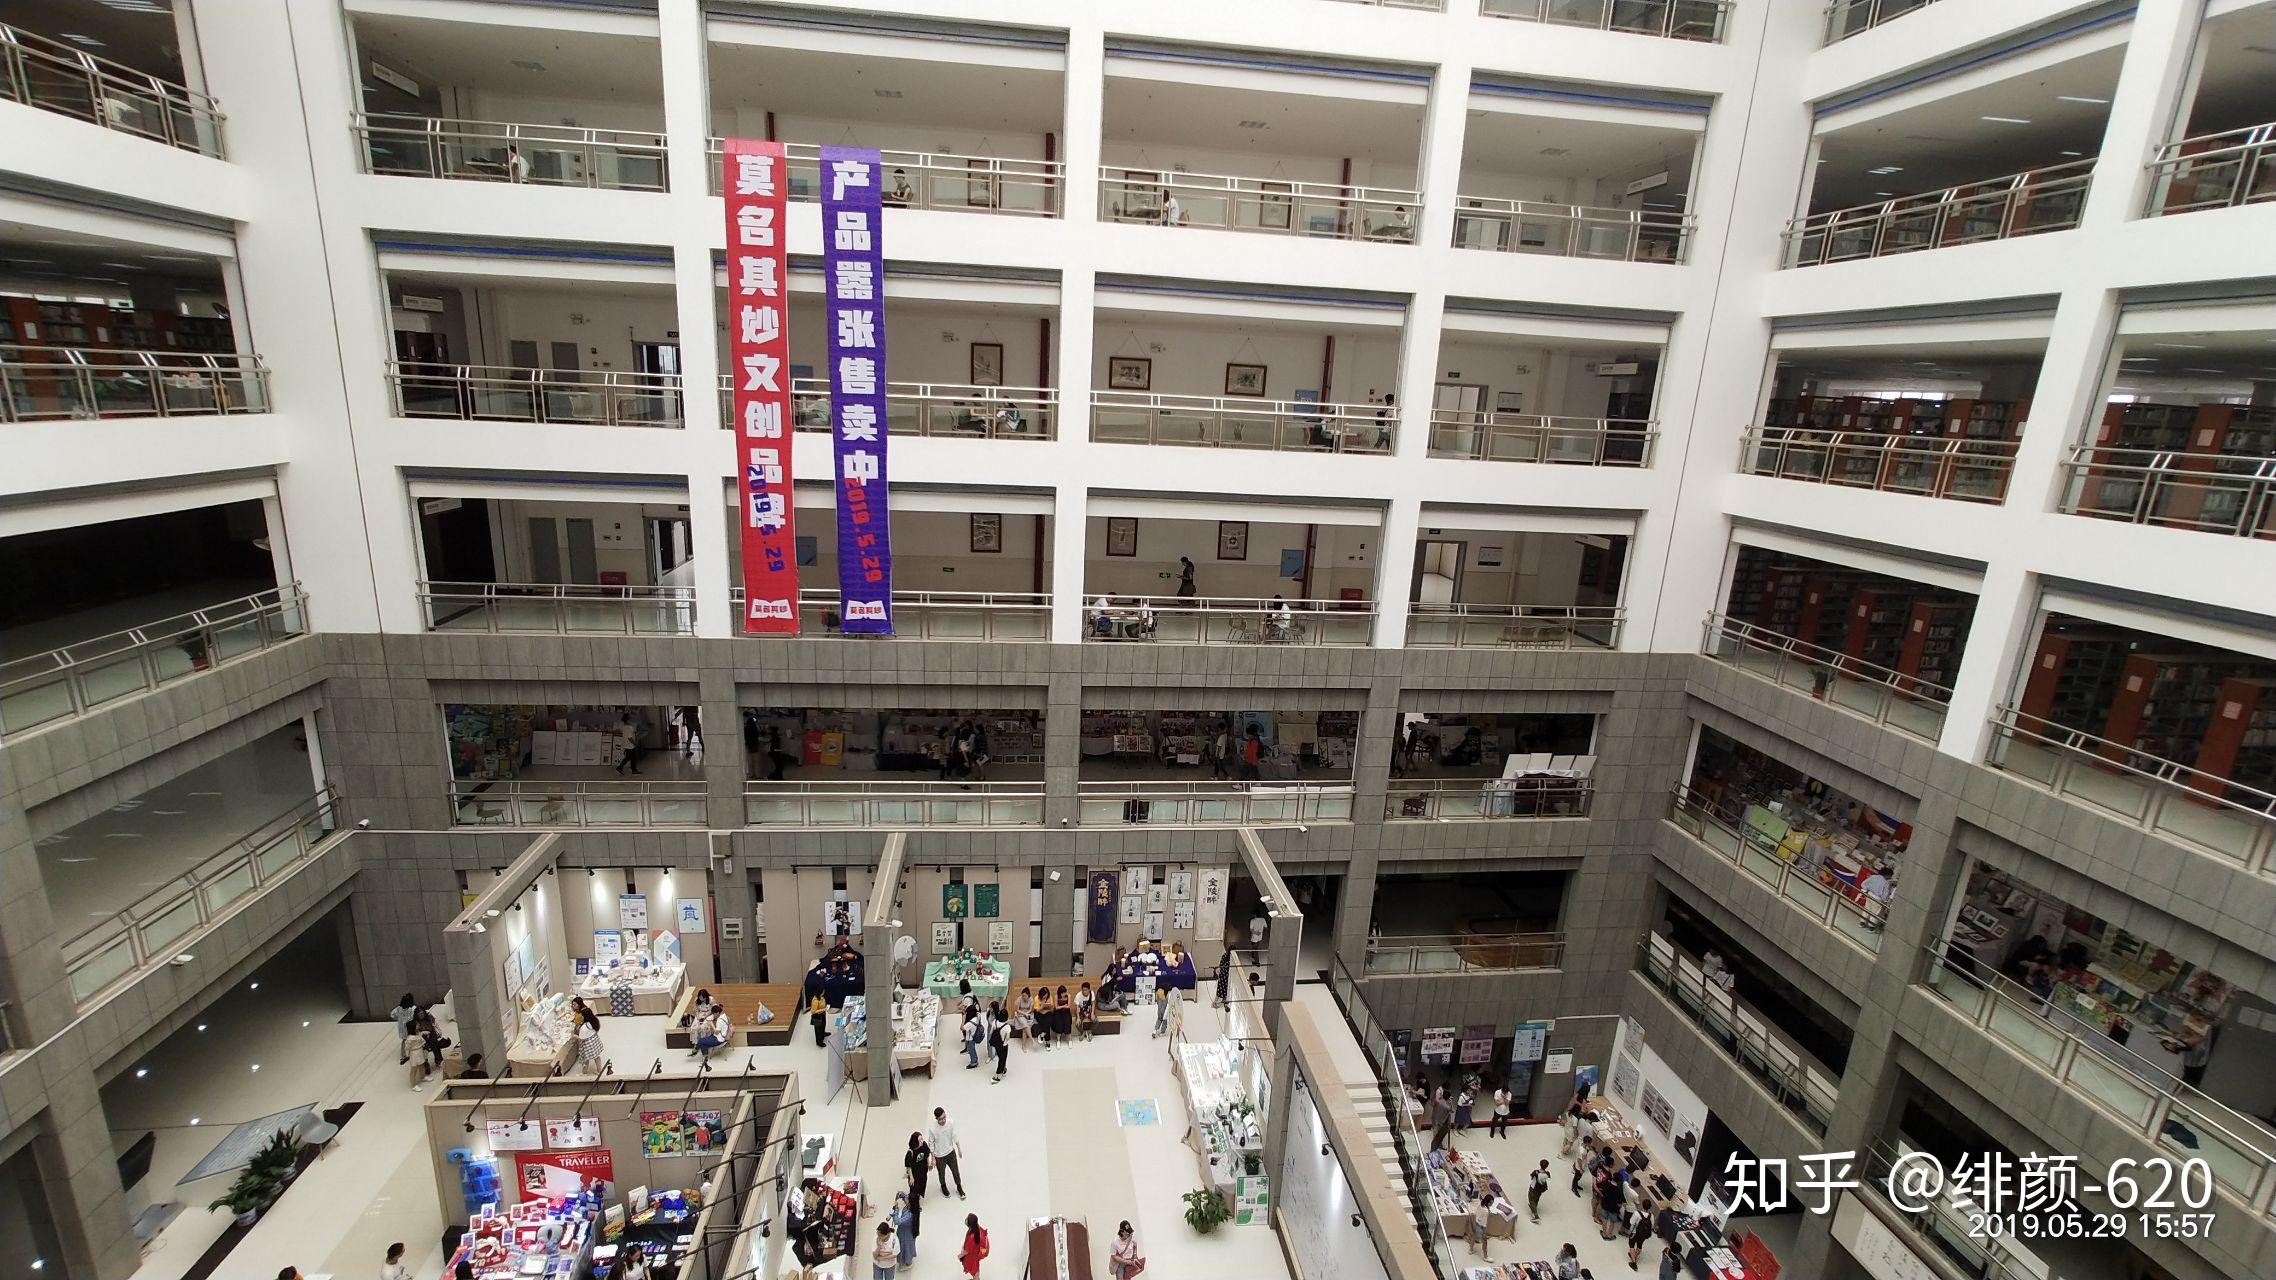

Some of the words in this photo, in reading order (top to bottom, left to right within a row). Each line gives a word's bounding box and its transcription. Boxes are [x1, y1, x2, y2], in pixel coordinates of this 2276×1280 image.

[736, 154, 786, 529] 莫名其妙文创品牌
[832, 160, 879, 487] 产品嚣张售卖中
[746, 464, 785, 572] 2019.5.29
[843, 476, 884, 583] 2019.5.29
[755, 604, 788, 613] 莫名其妙
[850, 606, 882, 615] 莫名其妙
[560, 1155, 610, 1167] TRAVELER
